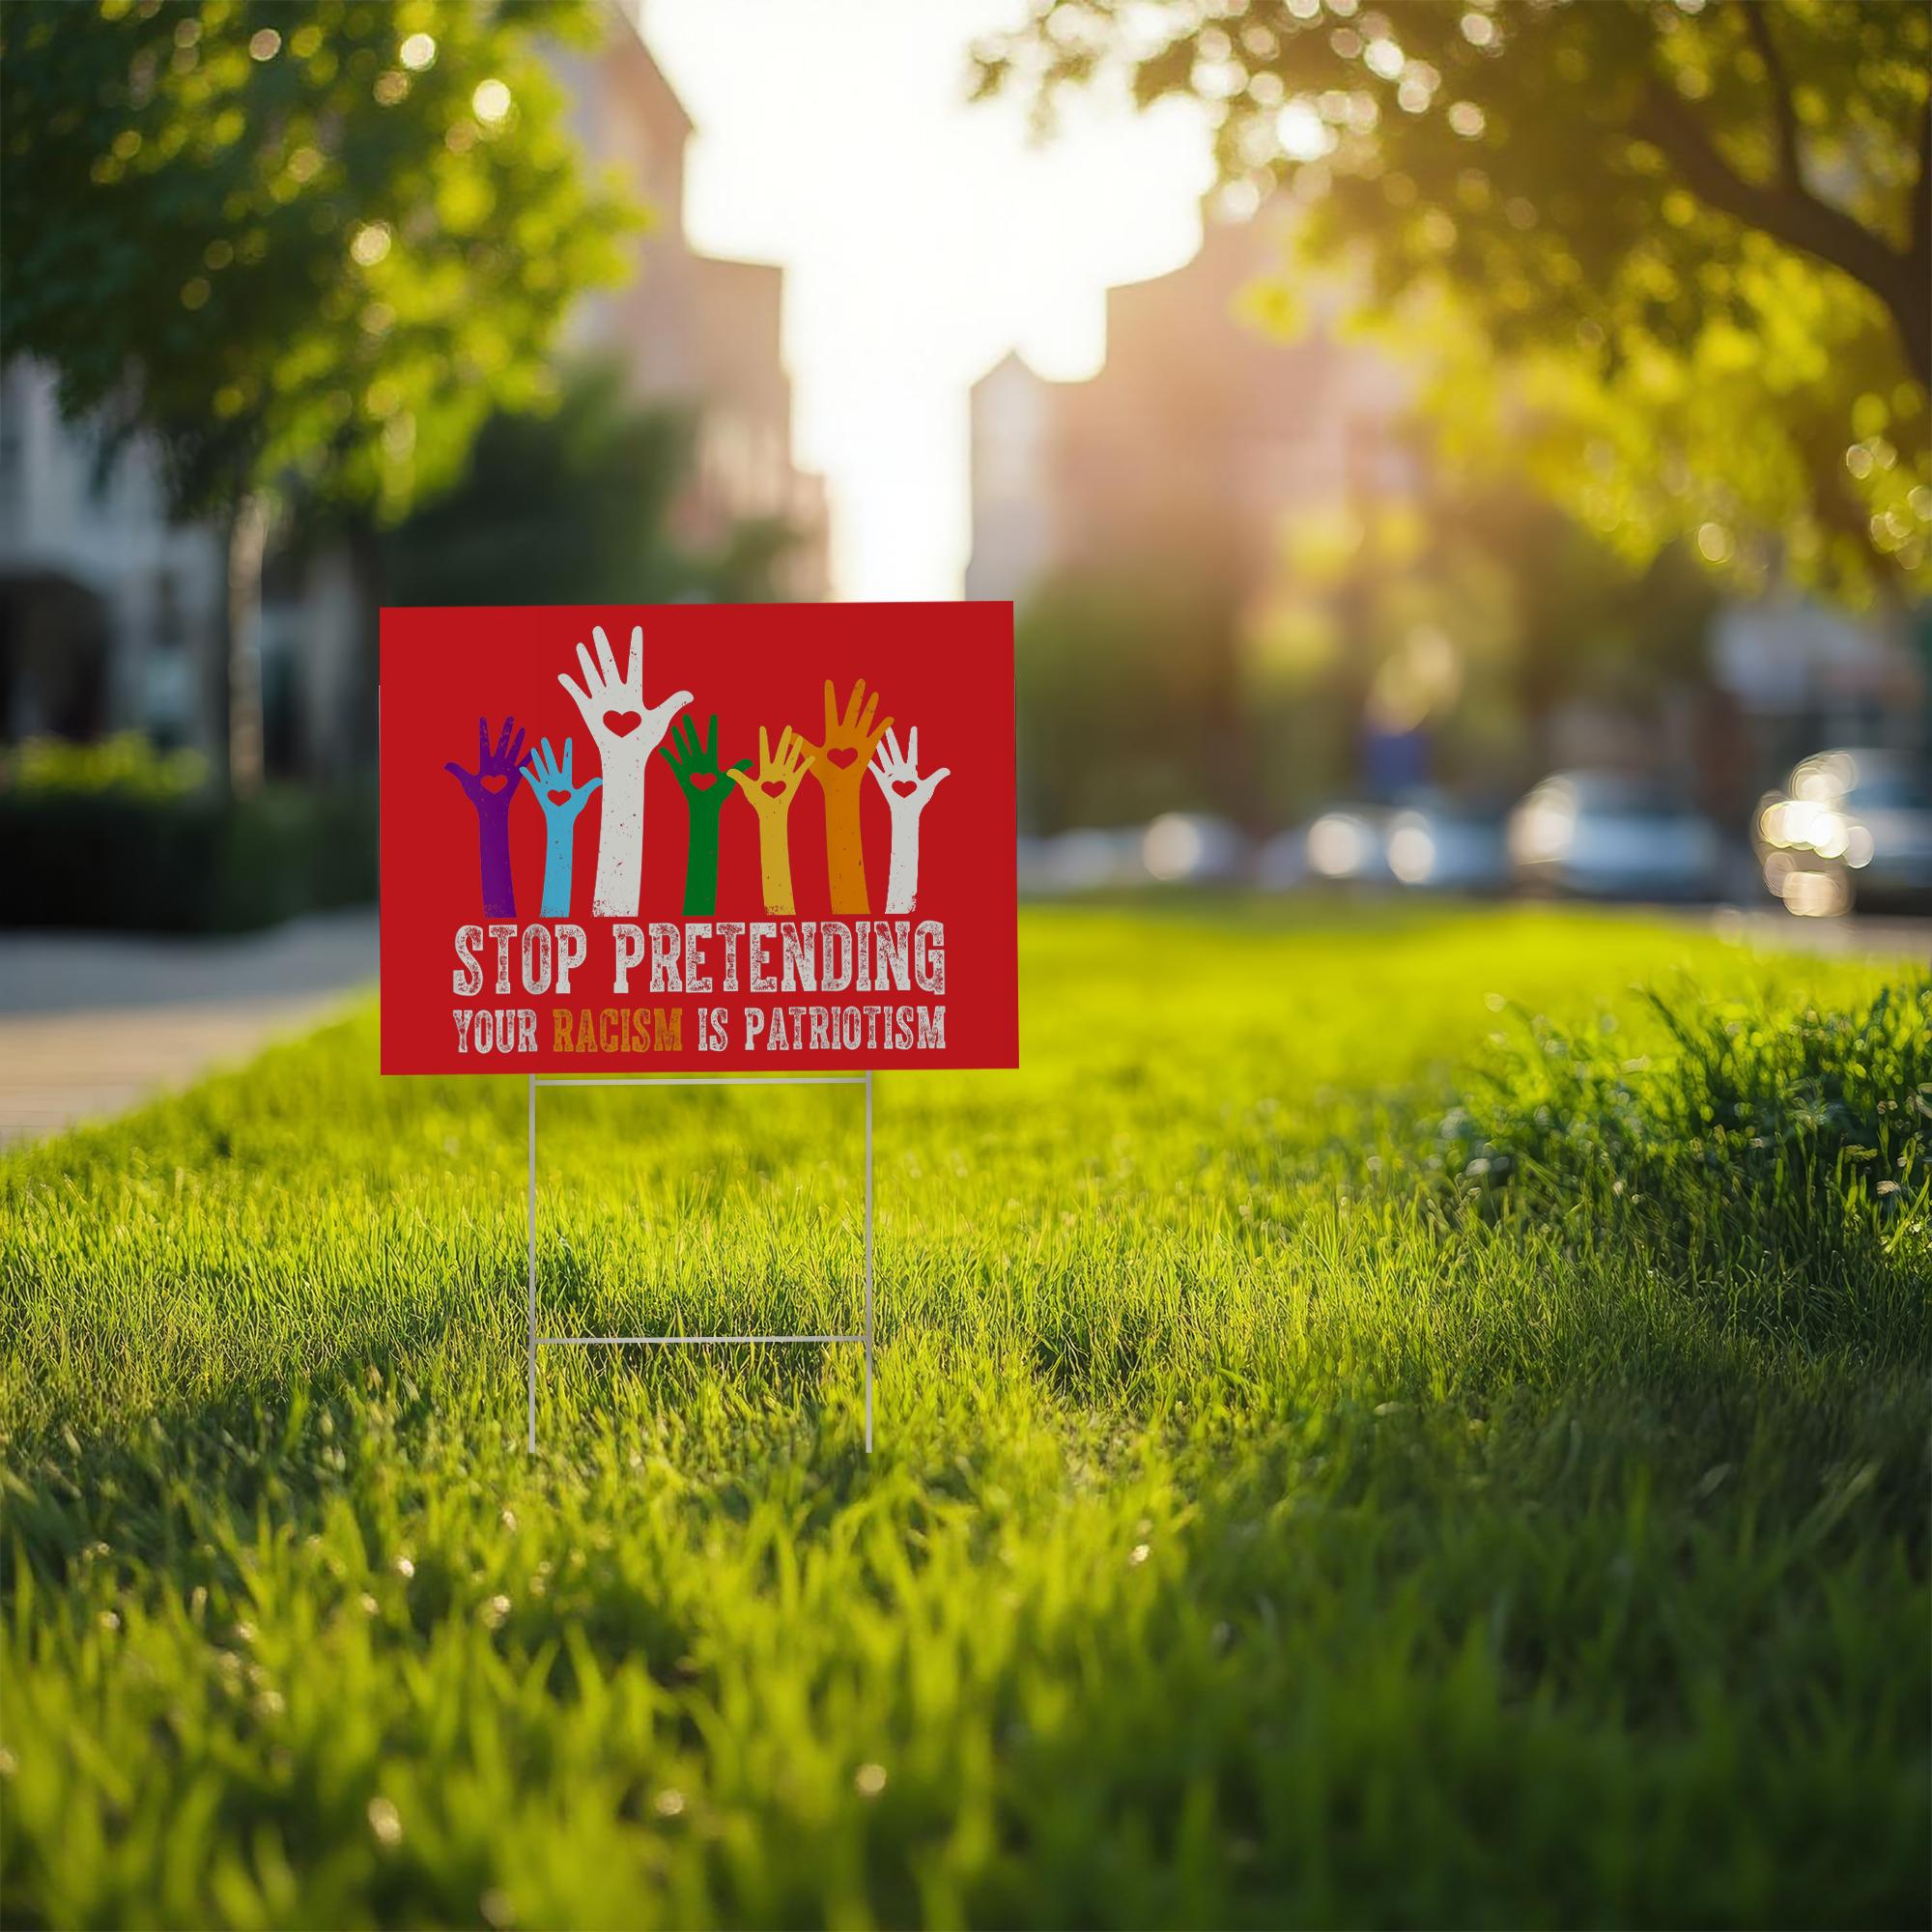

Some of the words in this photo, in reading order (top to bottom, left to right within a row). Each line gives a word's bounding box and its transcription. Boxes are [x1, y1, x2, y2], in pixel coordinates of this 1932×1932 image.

[453, 923, 586, 996] STOP
[612, 920, 945, 995] PRETENDING
[452, 1009, 538, 1054] YOUR
[553, 1009, 682, 1052] RACISM
[698, 1008, 728, 1052] IS
[745, 1006, 946, 1051] PATRIOTISM
